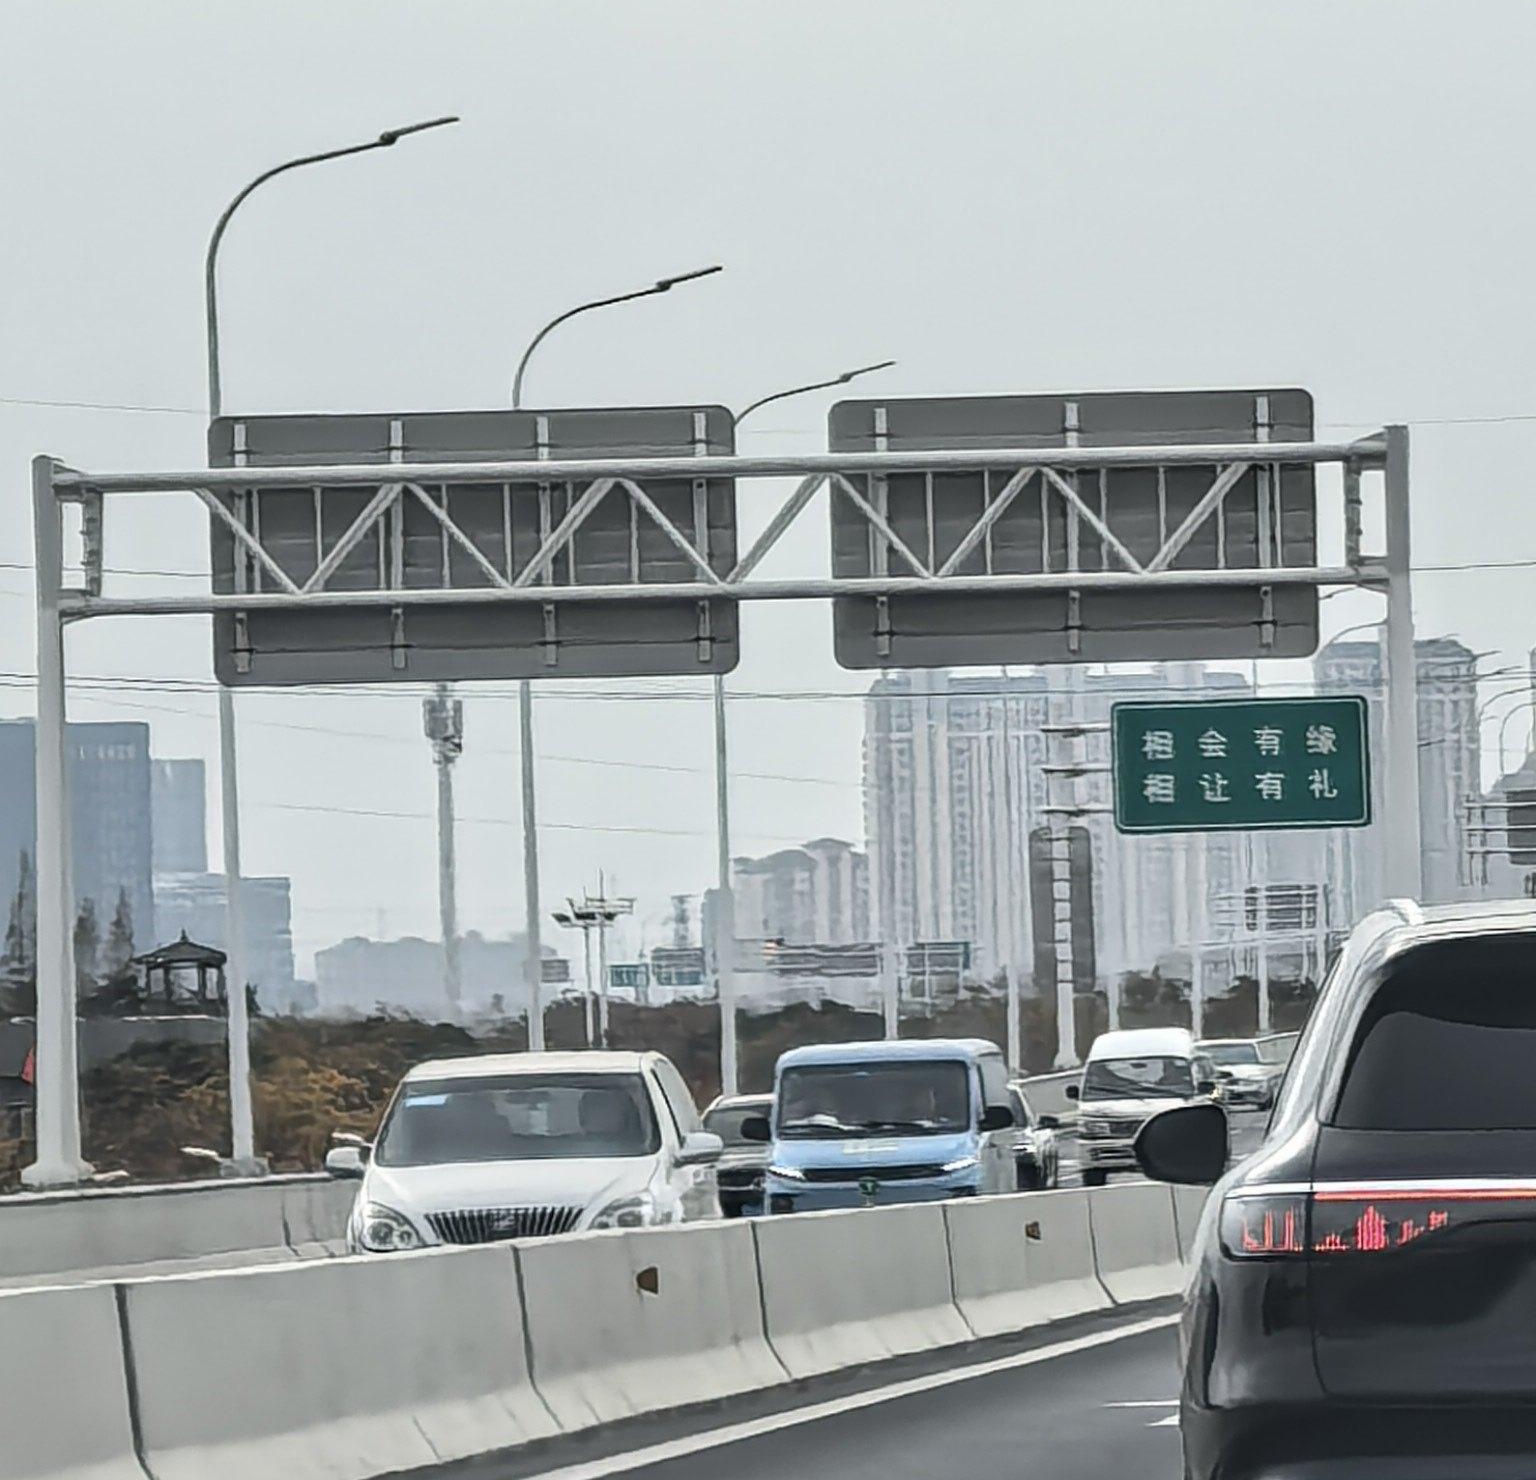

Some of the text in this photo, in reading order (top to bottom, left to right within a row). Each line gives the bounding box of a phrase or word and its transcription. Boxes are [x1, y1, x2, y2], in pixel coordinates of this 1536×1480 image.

[1142, 725, 1337, 760] 相会有缘
[1143, 768, 1338, 803] 相让有礼
